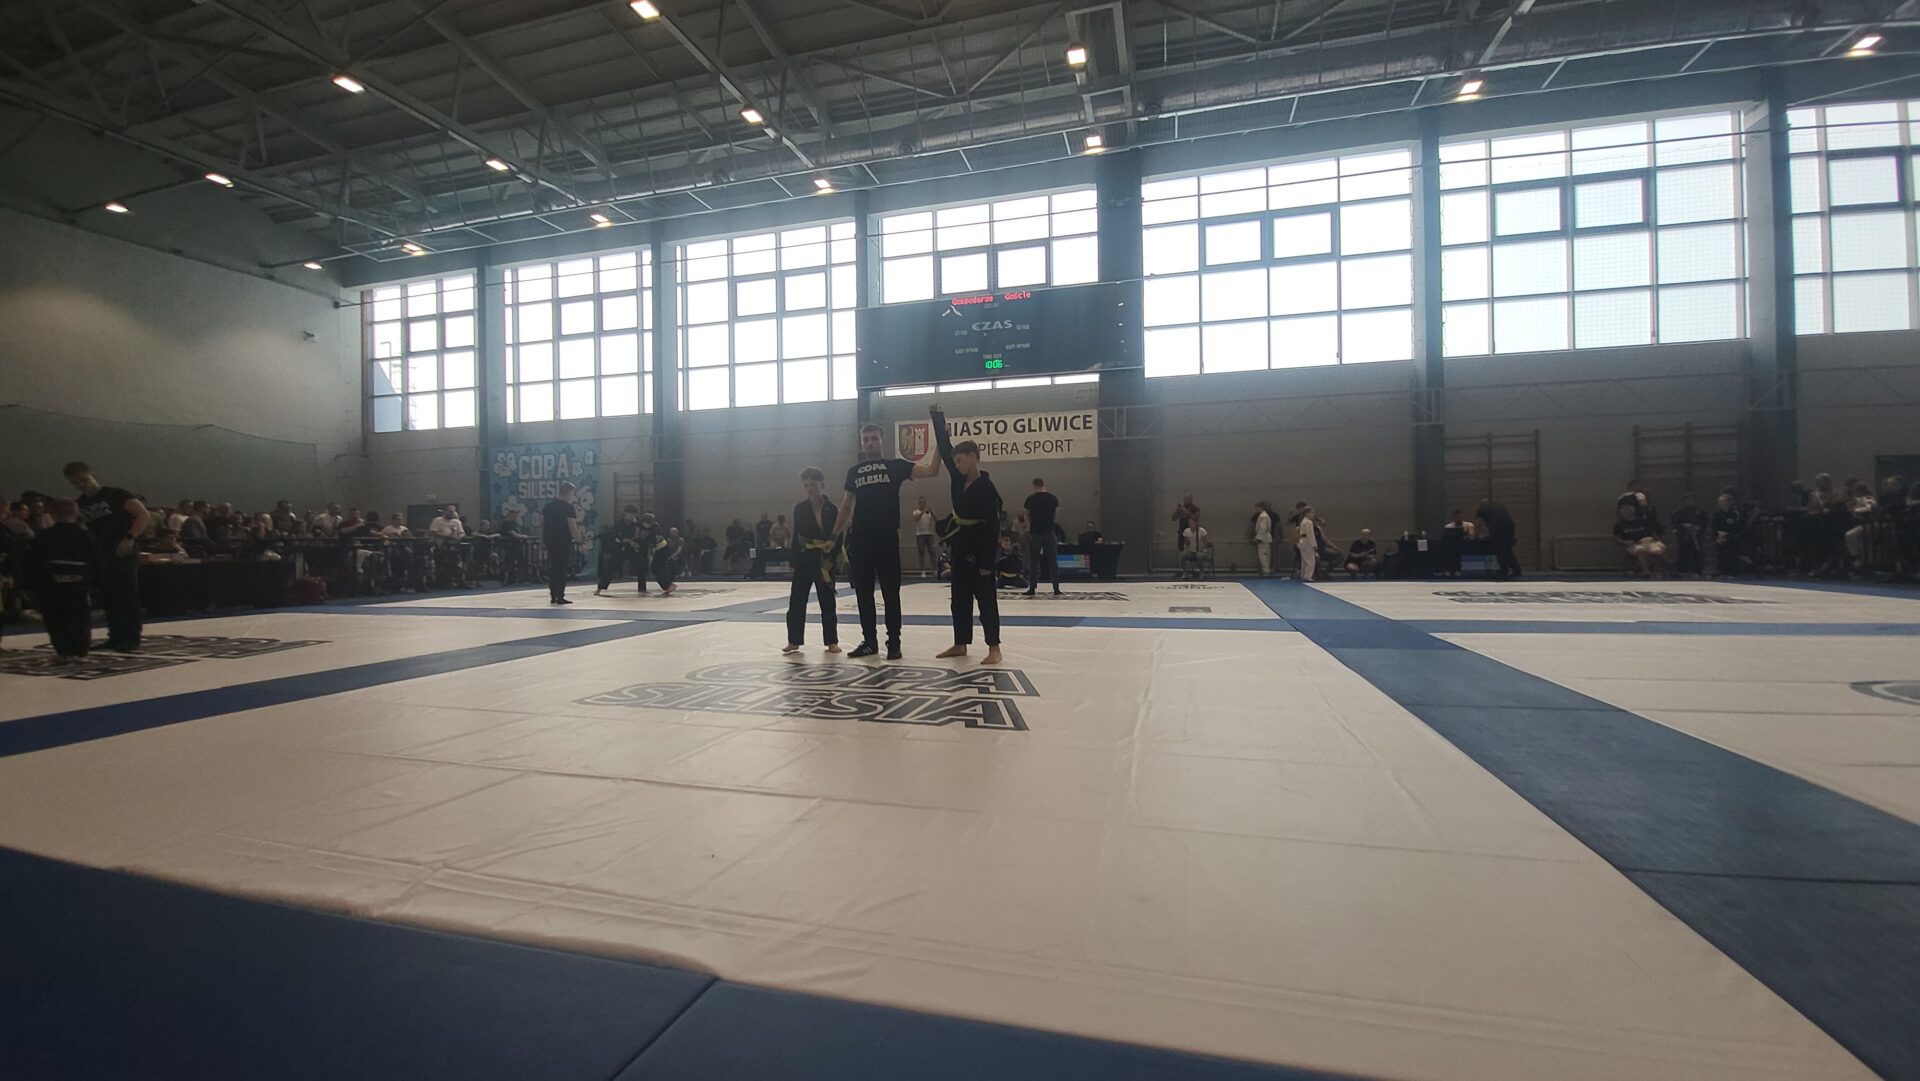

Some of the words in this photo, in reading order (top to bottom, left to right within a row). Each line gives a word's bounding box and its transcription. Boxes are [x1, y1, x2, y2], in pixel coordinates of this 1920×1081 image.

[971, 319, 1013, 331] CZAS
[1012, 414, 1093, 434] GLIWICE
[978, 442, 1020, 456] PIERA
[1024, 438, 1073, 455] SPORT
[518, 453, 569, 480] COPA
[857, 463, 887, 474] COPA
[518, 480, 560, 500] SILESI
[854, 473, 890, 488] SILESIA
[683, 660, 1041, 697] COPA
[572, 680, 1030, 732] SILESIA
